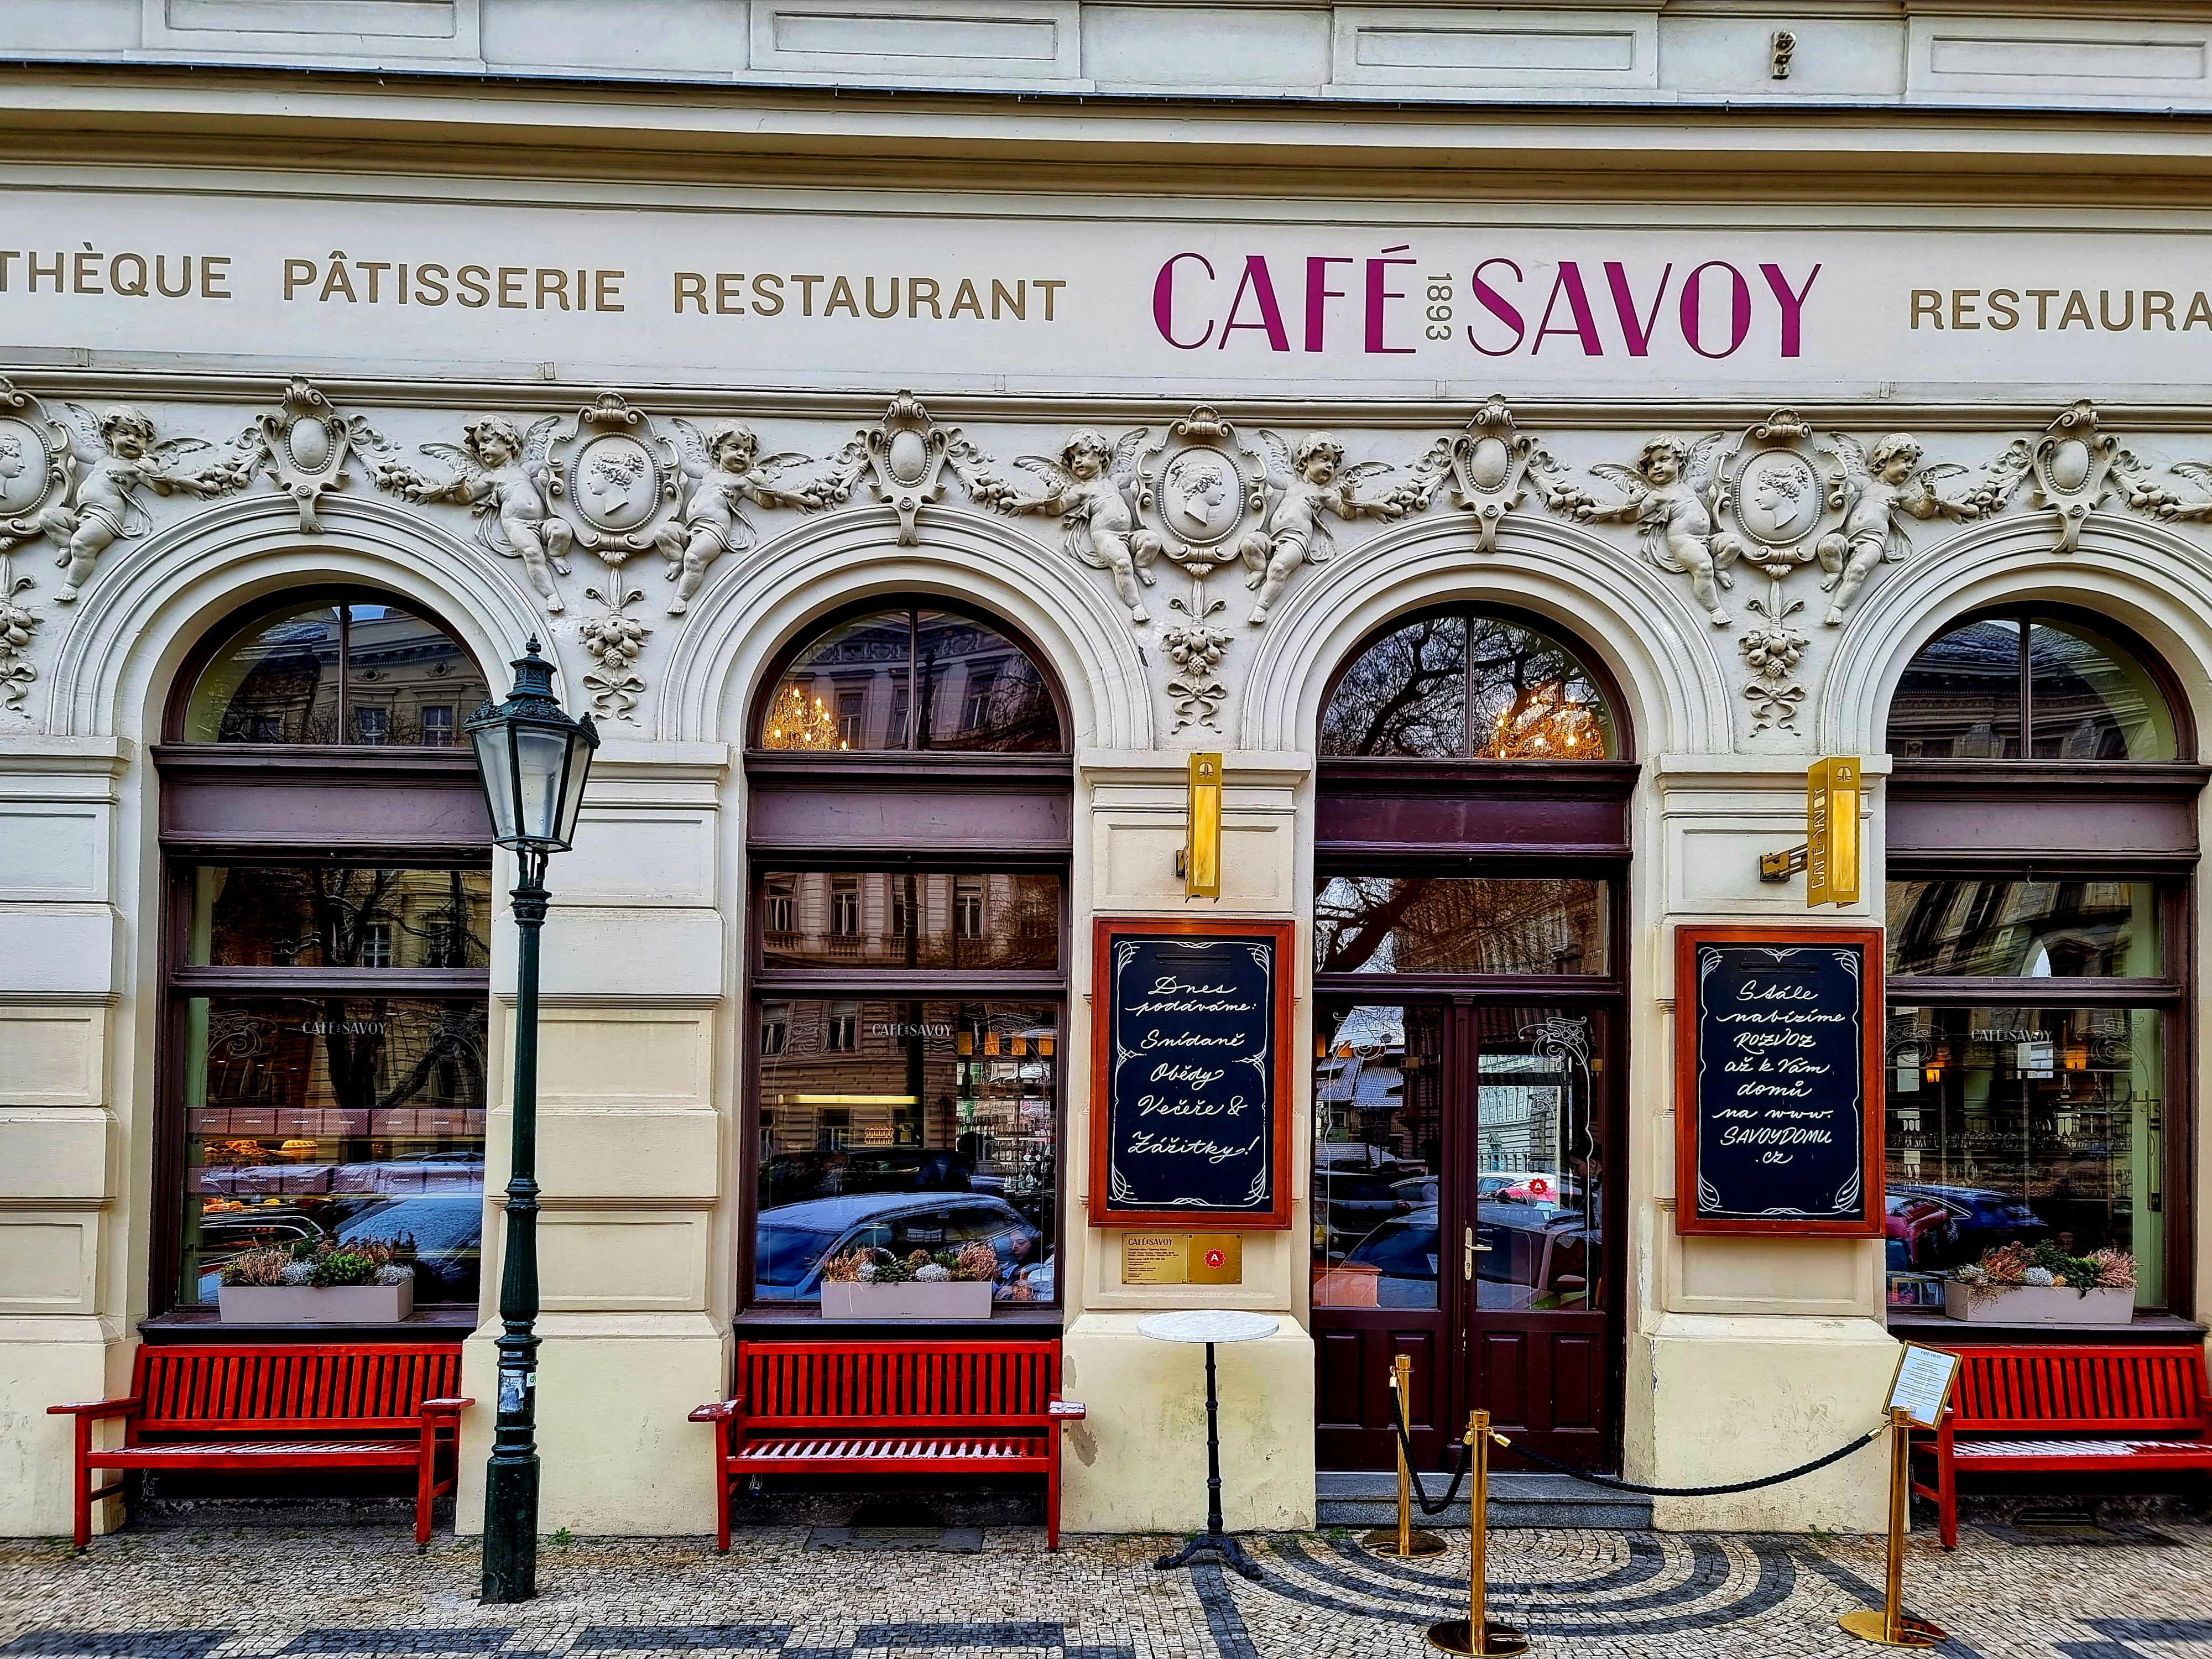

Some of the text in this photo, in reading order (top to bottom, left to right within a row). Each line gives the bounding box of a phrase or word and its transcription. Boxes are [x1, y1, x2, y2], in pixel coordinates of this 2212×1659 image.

[283, 250, 625, 312] PÂTISSERIE
[674, 272, 1067, 322] RESTAURANT
[1152, 244, 1823, 360] CAFÉ SAVOY
[1425, 273, 1453, 341] 1893
[1910, 288, 2212, 332] RESTAURA
[1147, 975, 1237, 995] Dnes
[1736, 979, 1819, 1001] Stále
[1125, 999, 1256, 1017] podáváme:
[1715, 1008, 1845, 1023] nabízíme
[342, 1021, 386, 1035] SAVOY
[910, 1024, 952, 1037] SAVOY
[2008, 1029, 2052, 1042] SAVOY
[1140, 1029, 1245, 1049] Snídaně
[1724, 1056, 1830, 1074] až k Vám
[1150, 1062, 1224, 1091] Obědy
[1736, 1080, 1813, 1097] domů
[1138, 1094, 1248, 1117] Večeře &
[1712, 1108, 1834, 1119] na www.
[1720, 1126, 1832, 1146] SAVOYDOMU
[1128, 1131, 1260, 1164] Zážitky!
